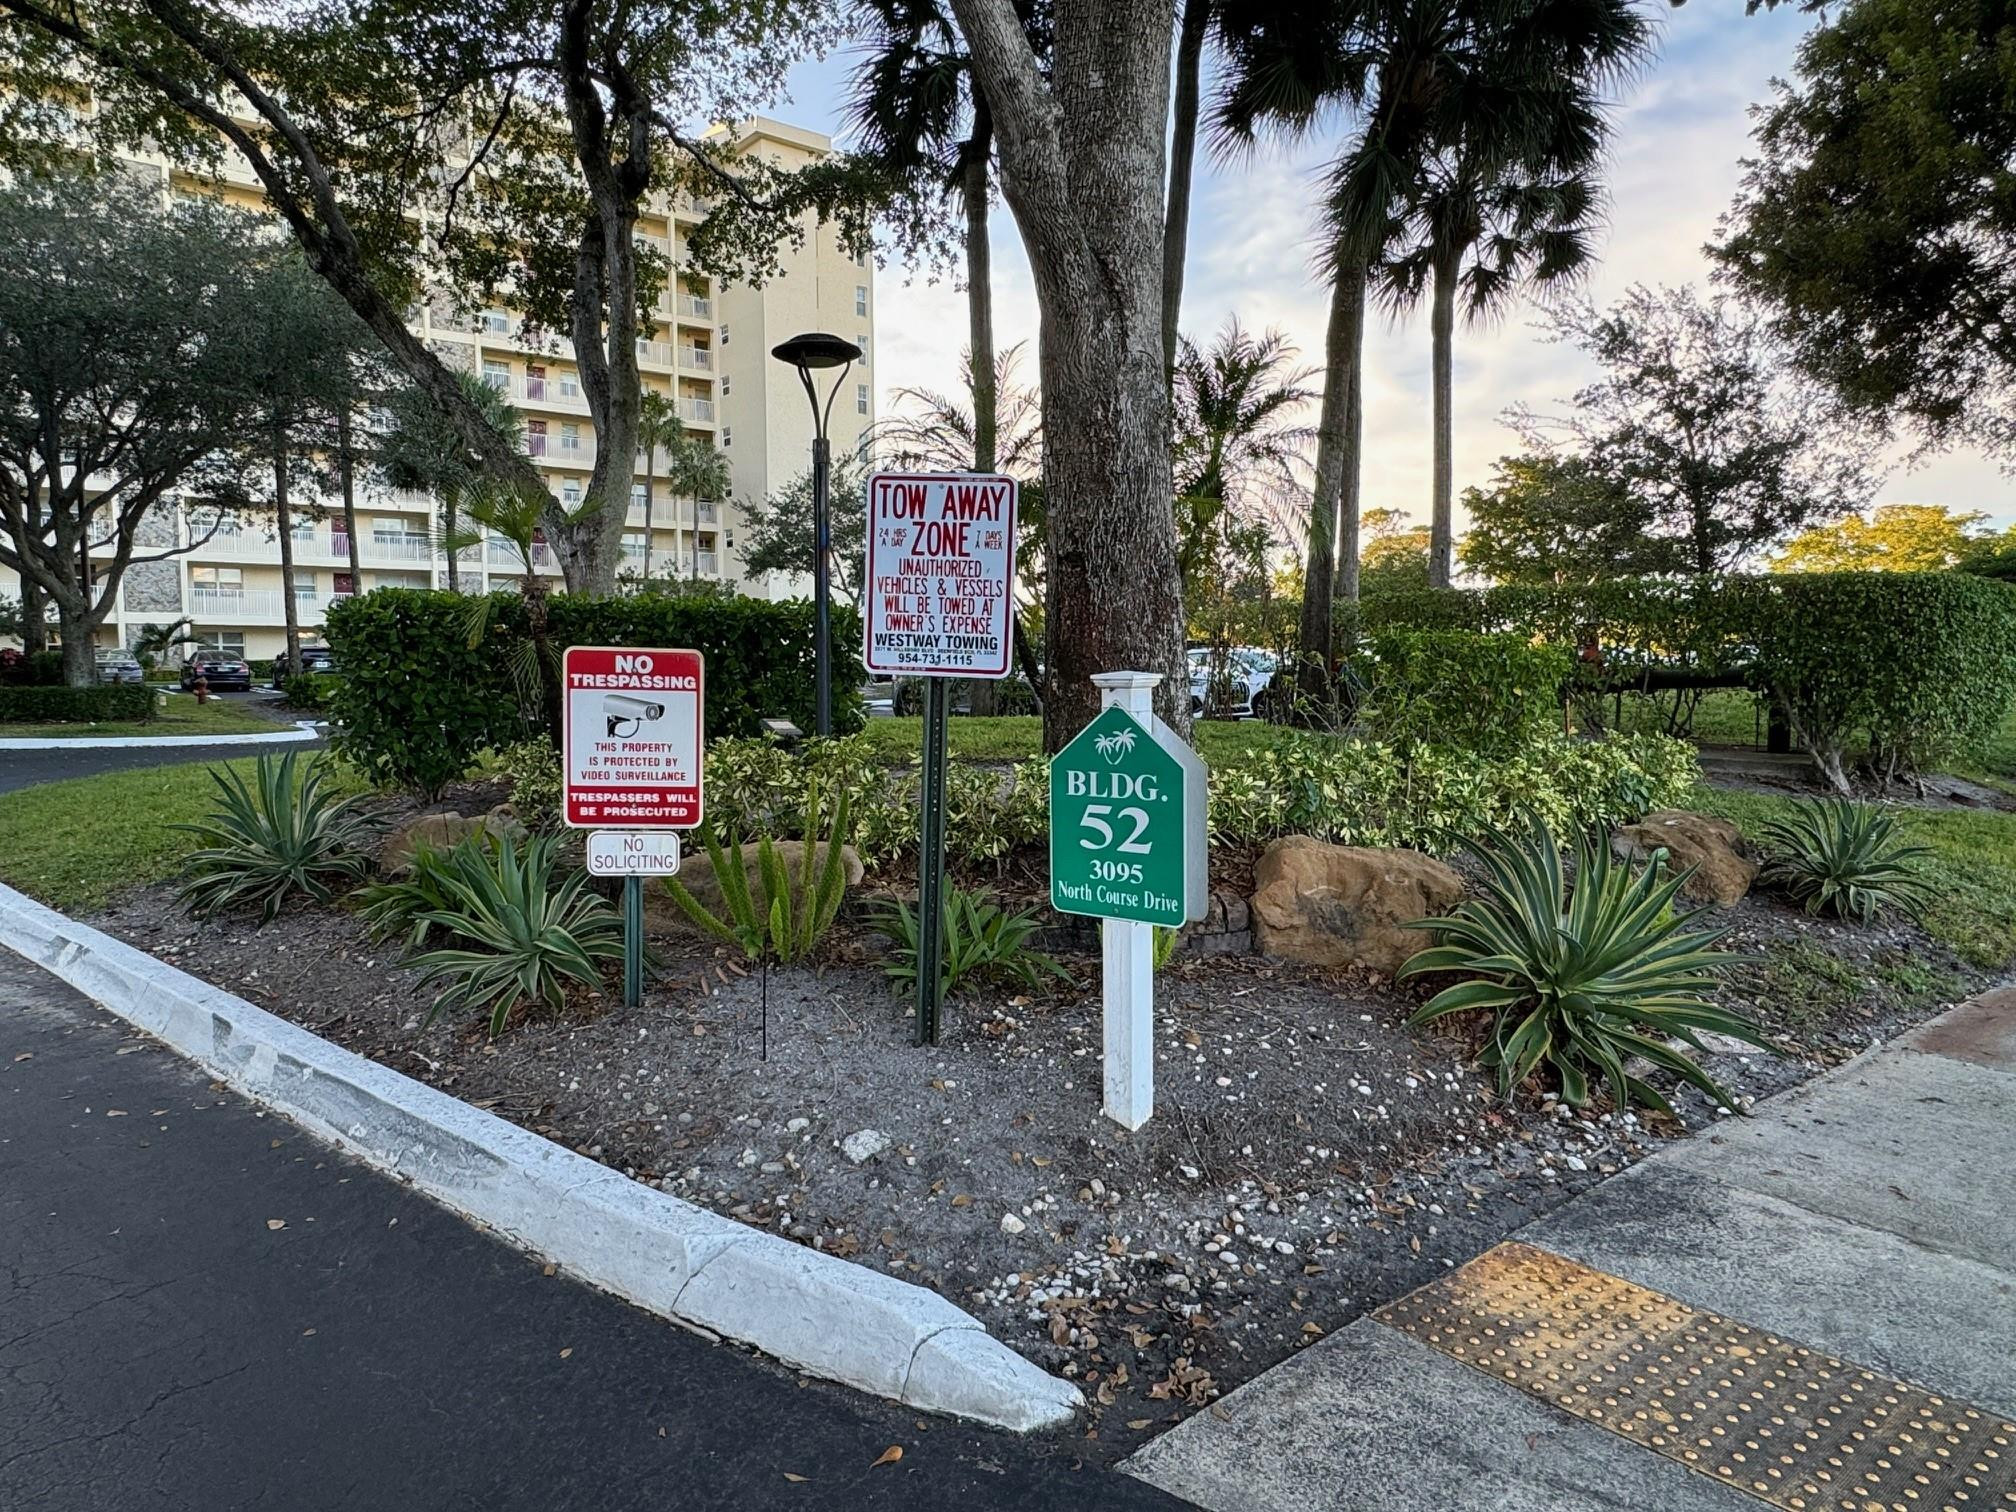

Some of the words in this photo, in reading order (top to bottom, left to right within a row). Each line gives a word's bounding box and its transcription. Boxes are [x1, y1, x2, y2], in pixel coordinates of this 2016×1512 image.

[879, 484, 928, 520] TOW
[941, 485, 1006, 521] AWAY
[879, 528, 889, 537] 24
[893, 529, 907, 537] HRS
[911, 522, 971, 557] ZONE
[976, 530, 981, 539] 7
[986, 531, 1002, 540] DAYS
[881, 538, 887, 546] A
[891, 538, 905, 547] DAY
[975, 540, 980, 549] A
[984, 541, 1002, 550] WEEK
[899, 559, 982, 577] UNAUTHORIZED
[878, 576, 928, 595] VEHICLES
[938, 580, 946, 595] &
[955, 580, 1003, 597] VESSELS
[885, 596, 909, 613] WILL
[917, 597, 931, 614] BE
[939, 598, 975, 615] TOWED
[982, 599, 994, 615] AT
[885, 614, 935, 632] OWNER'S
[943, 616, 992, 634] EXPENSE
[875, 633, 941, 647] WESTWAY
[946, 636, 998, 650] TOWING
[615, 655, 654, 674] NO
[898, 653, 973, 665] 954-731-1115
[570, 674, 696, 689] TRESPASSING
[595, 742, 617, 752] THIS
[622, 743, 673, 753] PROPERTY
[589, 757, 598, 766] IS
[604, 757, 661, 766] PROTECTED
[666, 758, 678, 767] BY
[581, 771, 610, 780] VIDEO
[615, 771, 686, 781] SURVEILLANCE
[1066, 770, 1168, 802] BLDG.
[570, 792, 660, 802] TRESPASSERS
[667, 794, 696, 803] WILL
[579, 806, 597, 816] BE
[604, 807, 688, 816] PROSECUTED
[1080, 804, 1153, 855] 52
[623, 838, 644, 851] NO
[595, 855, 673, 868] SOLICITING
[1089, 859, 1144, 884] 3095
[1058, 880, 1092, 901] North
[1096, 885, 1139, 907] Course
[1144, 891, 1178, 912] Drive
